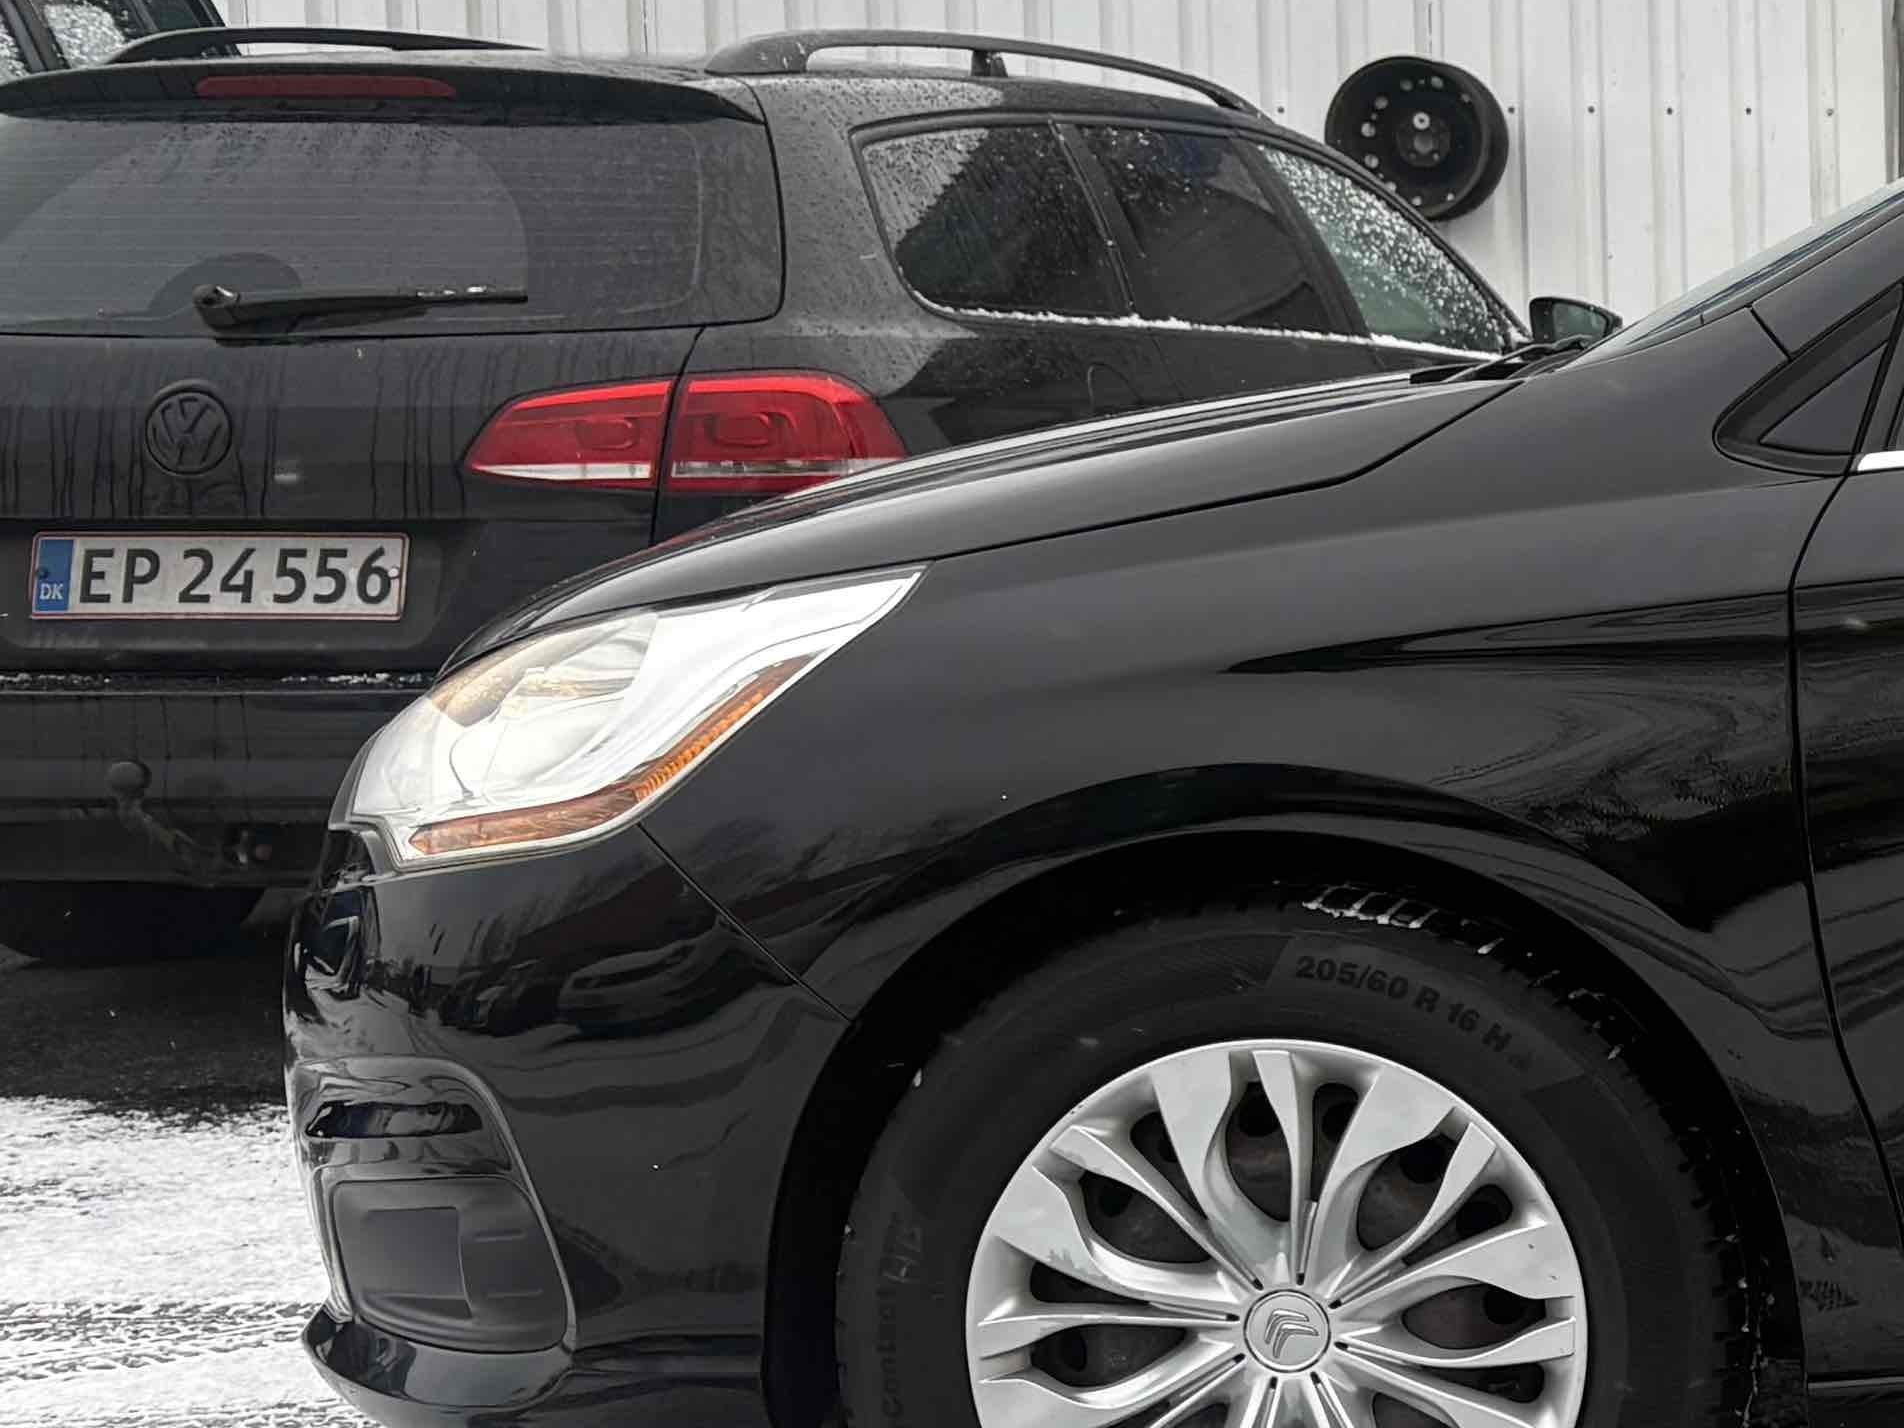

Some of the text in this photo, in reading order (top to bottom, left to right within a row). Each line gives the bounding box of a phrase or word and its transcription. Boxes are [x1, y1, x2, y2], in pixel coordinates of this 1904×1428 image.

[146, 389, 232, 475] VW
[39, 582, 64, 601] DK
[78, 545, 393, 606] EP 24 556
[1295, 955, 1513, 1054] 205/60 R 16 H
